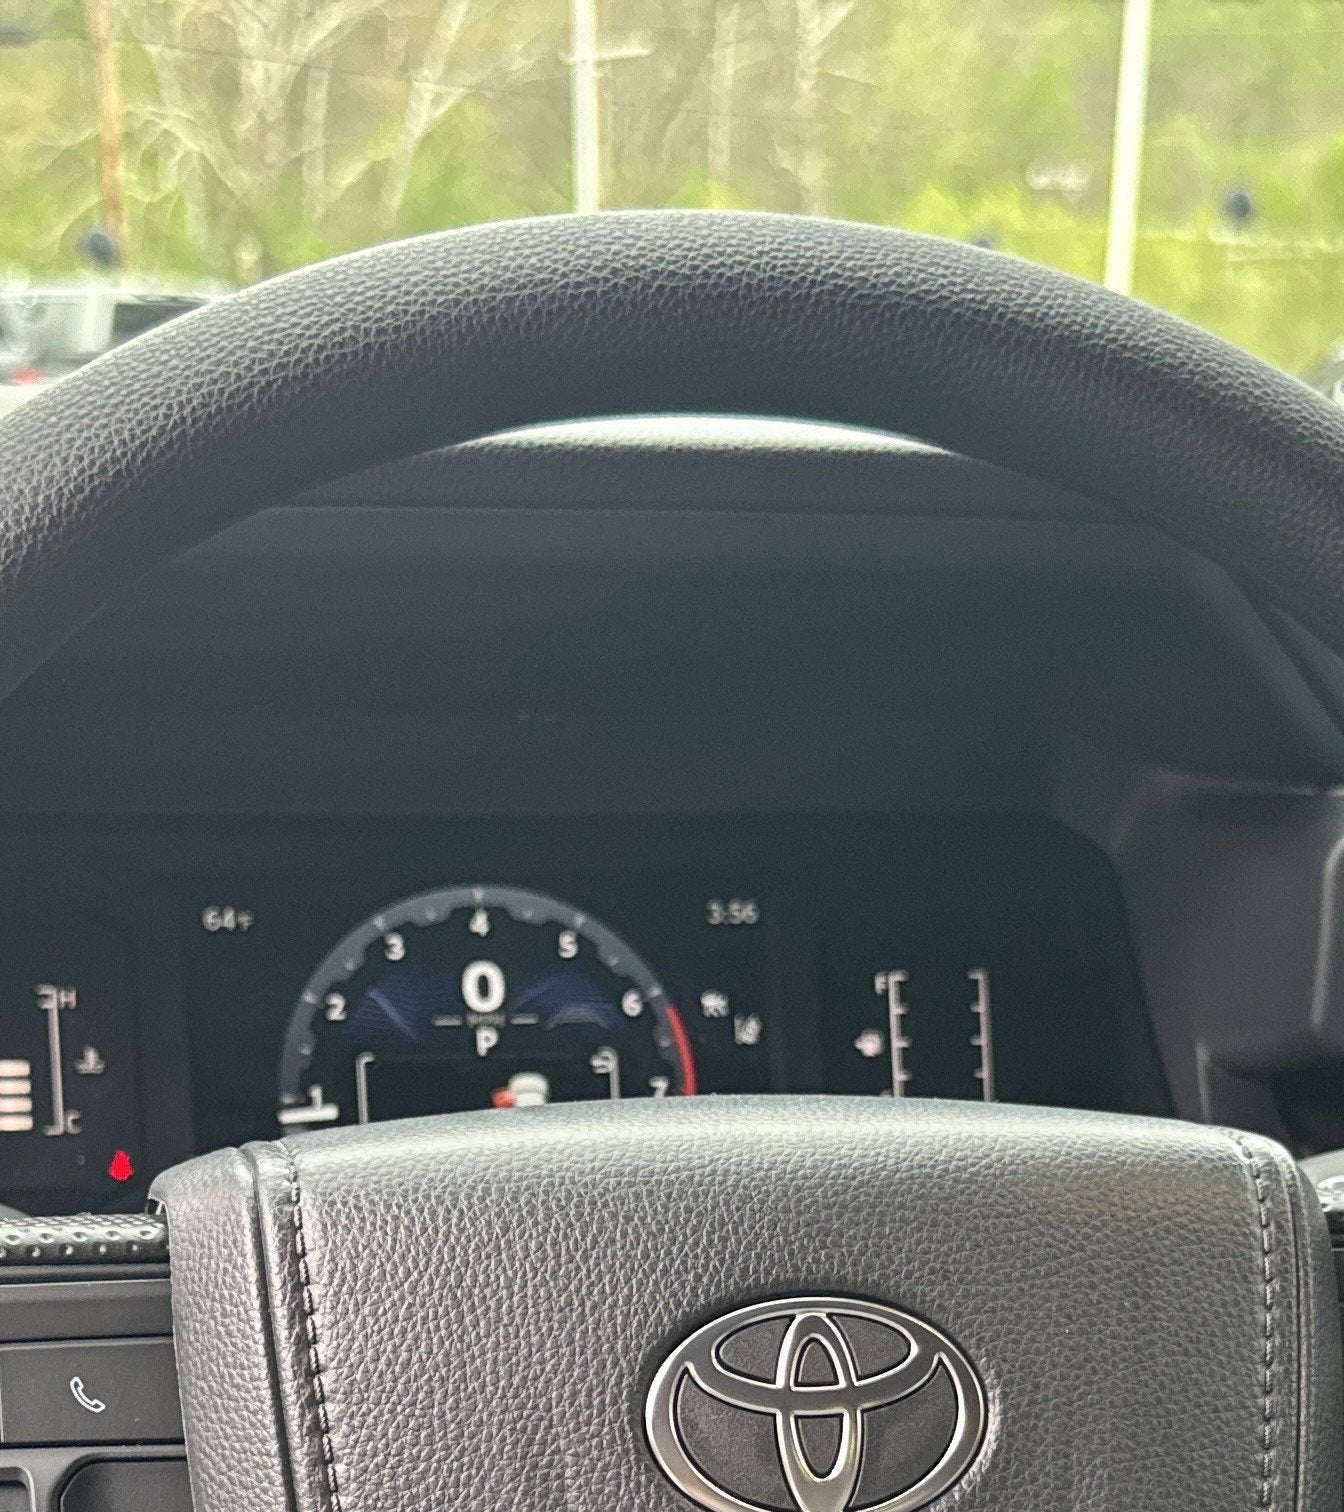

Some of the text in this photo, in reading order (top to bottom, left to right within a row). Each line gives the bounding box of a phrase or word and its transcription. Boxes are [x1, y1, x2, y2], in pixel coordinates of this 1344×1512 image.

[469, 908, 490, 937] 4
[707, 901, 759, 925] 3:56
[384, 932, 406, 961] 3
[558, 930, 578, 958] 5
[462, 960, 505, 1013] 0
[326, 993, 347, 1021] 2
[622, 990, 643, 1017] 6
[476, 1026, 499, 1057] P
[66, 1109, 82, 1134] C
